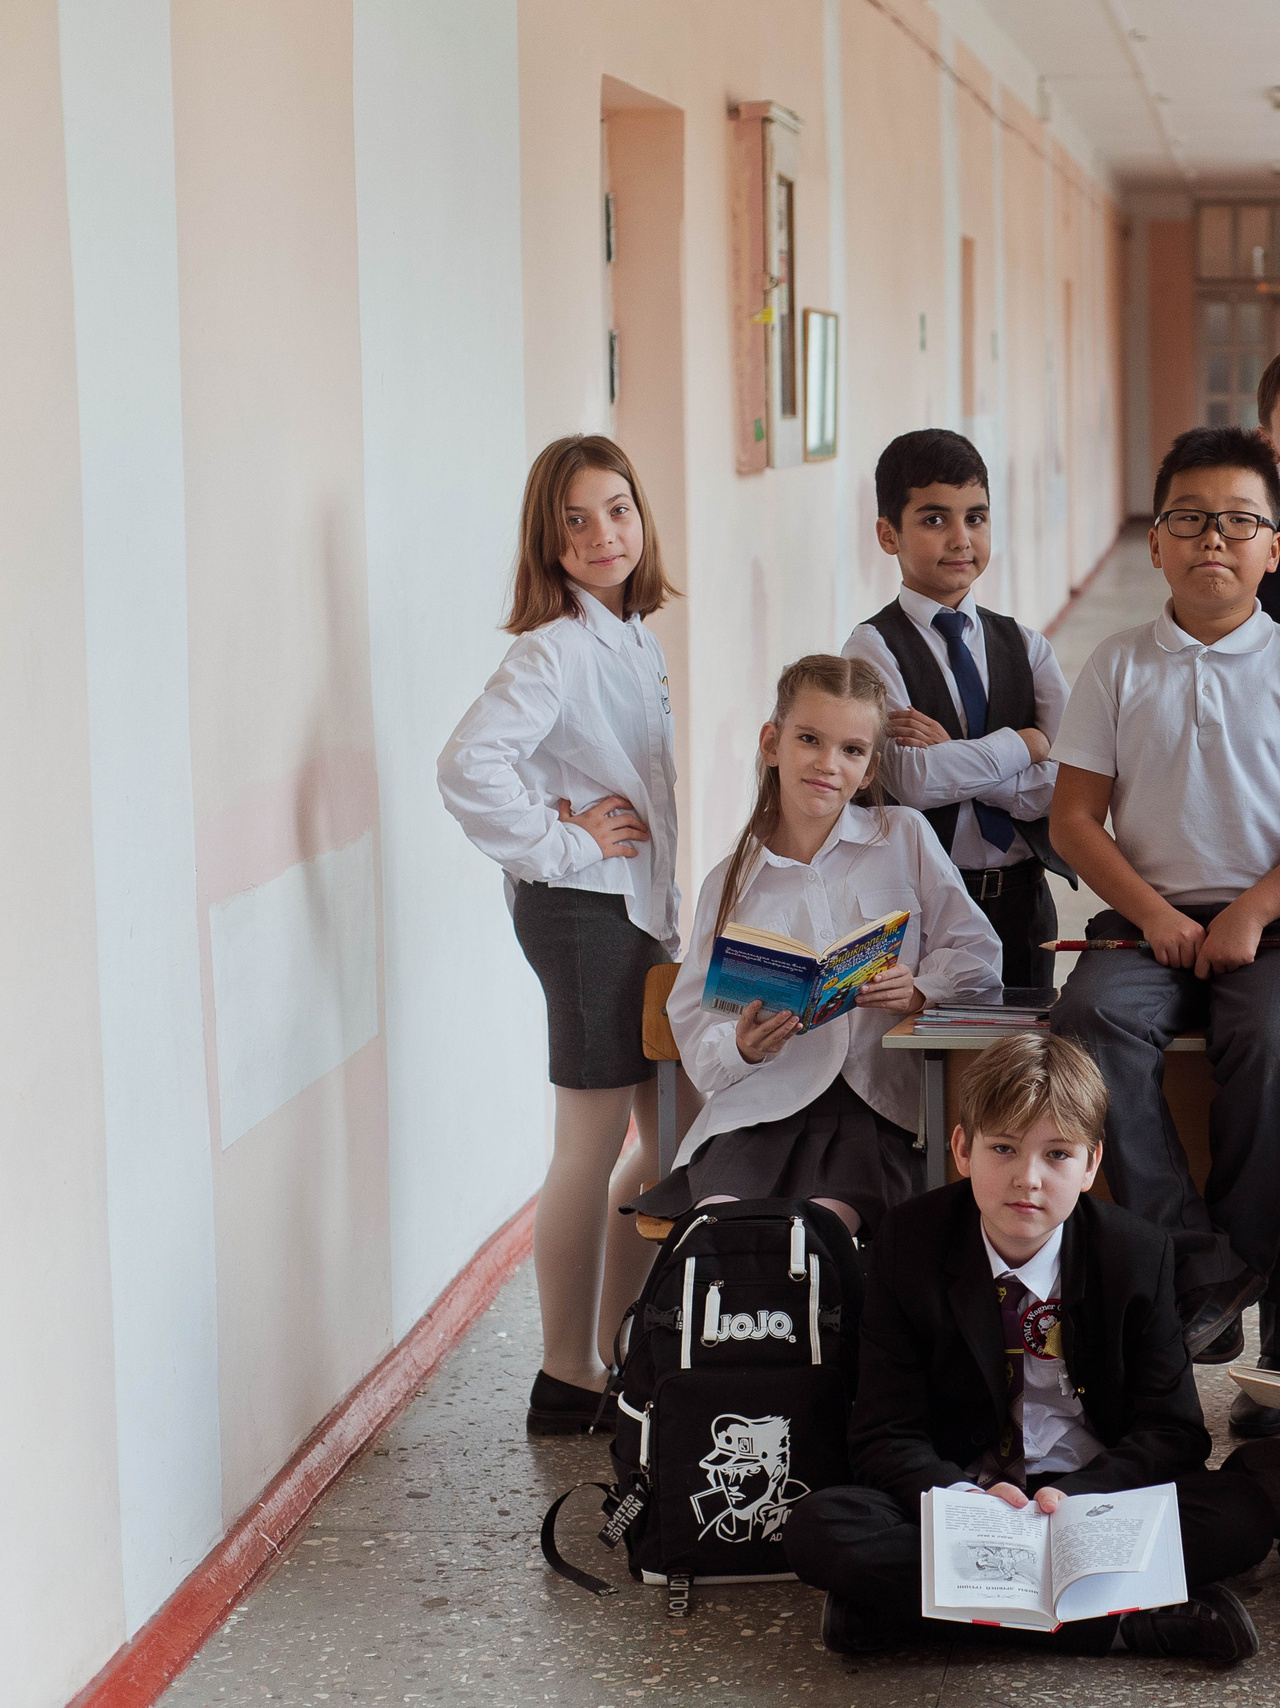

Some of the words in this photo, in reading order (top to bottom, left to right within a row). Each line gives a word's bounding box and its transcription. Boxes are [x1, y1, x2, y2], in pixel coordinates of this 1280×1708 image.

[1026, 1304, 1055, 1320] Wagner
[1023, 1321, 1034, 1342] PMC
[602, 1493, 636, 1535] LIMITED
[610, 1499, 645, 1543] EDITION
[769, 1532, 784, 1543] AD
